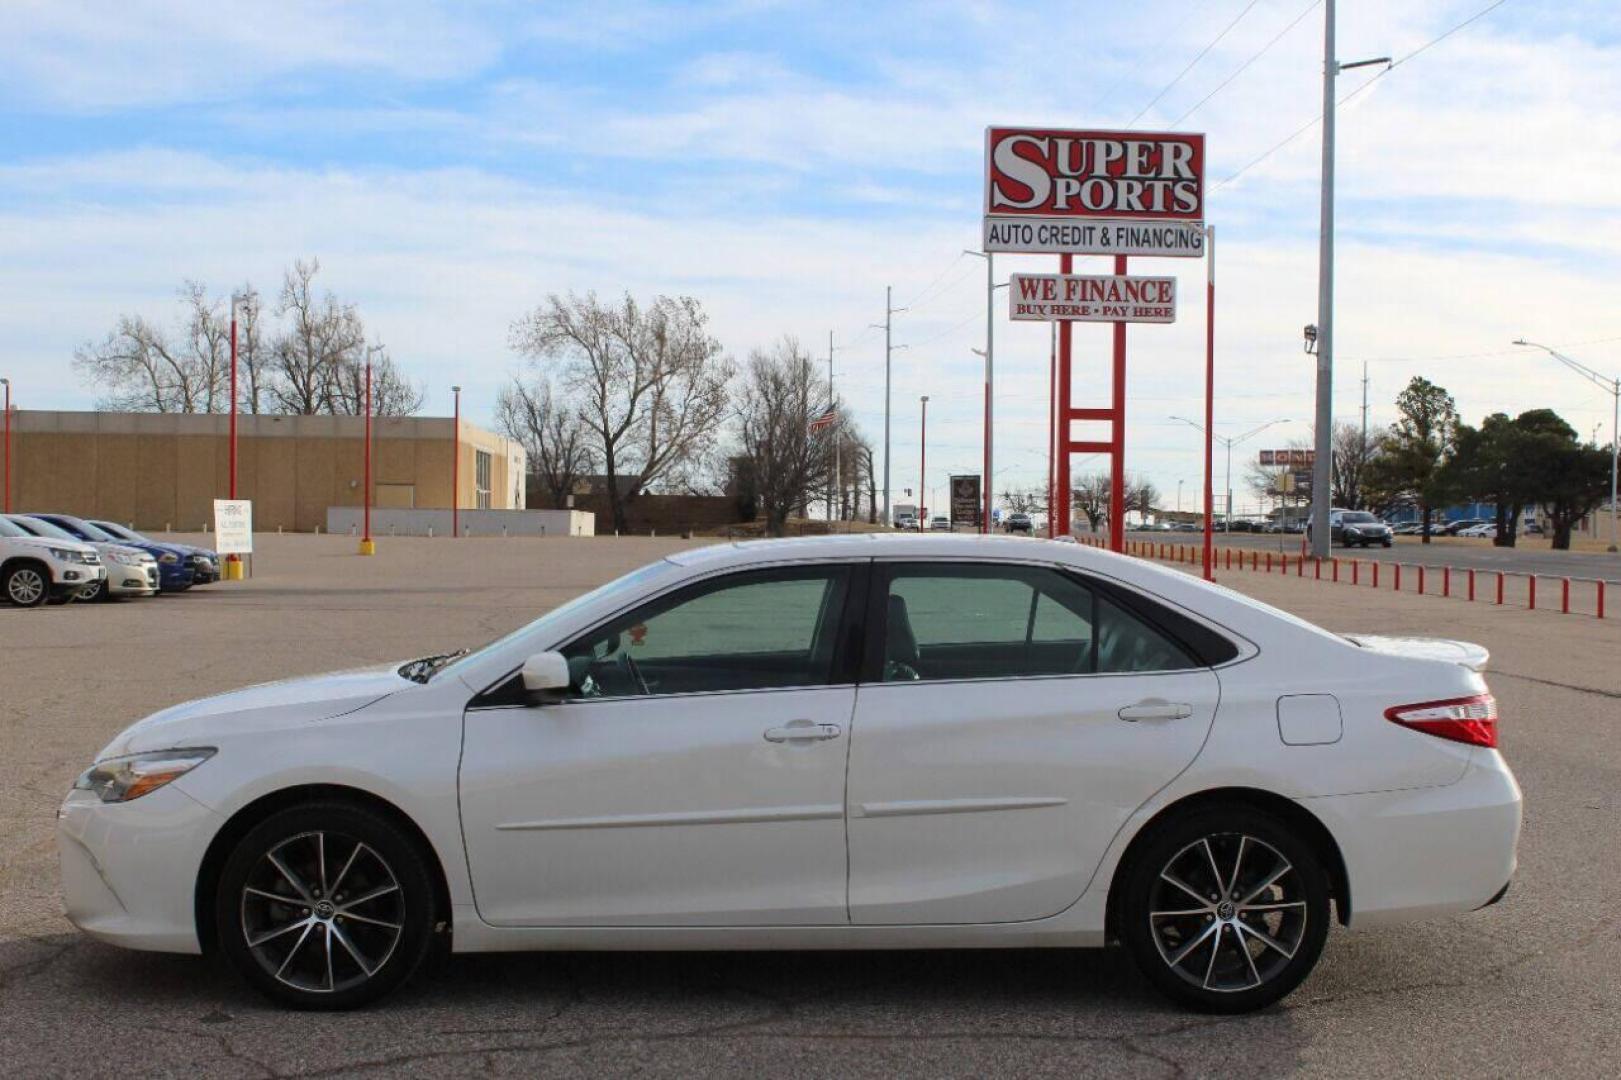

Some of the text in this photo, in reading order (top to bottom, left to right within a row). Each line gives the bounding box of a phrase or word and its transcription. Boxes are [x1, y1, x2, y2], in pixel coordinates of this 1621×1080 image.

[993, 134, 1196, 209] SUPER
[989, 224, 1202, 249] AUTO CREDIT & FINANCING
[1018, 276, 1172, 303] WE FINANCE
[1017, 304, 1172, 317] BUY HERE PAY HERE
